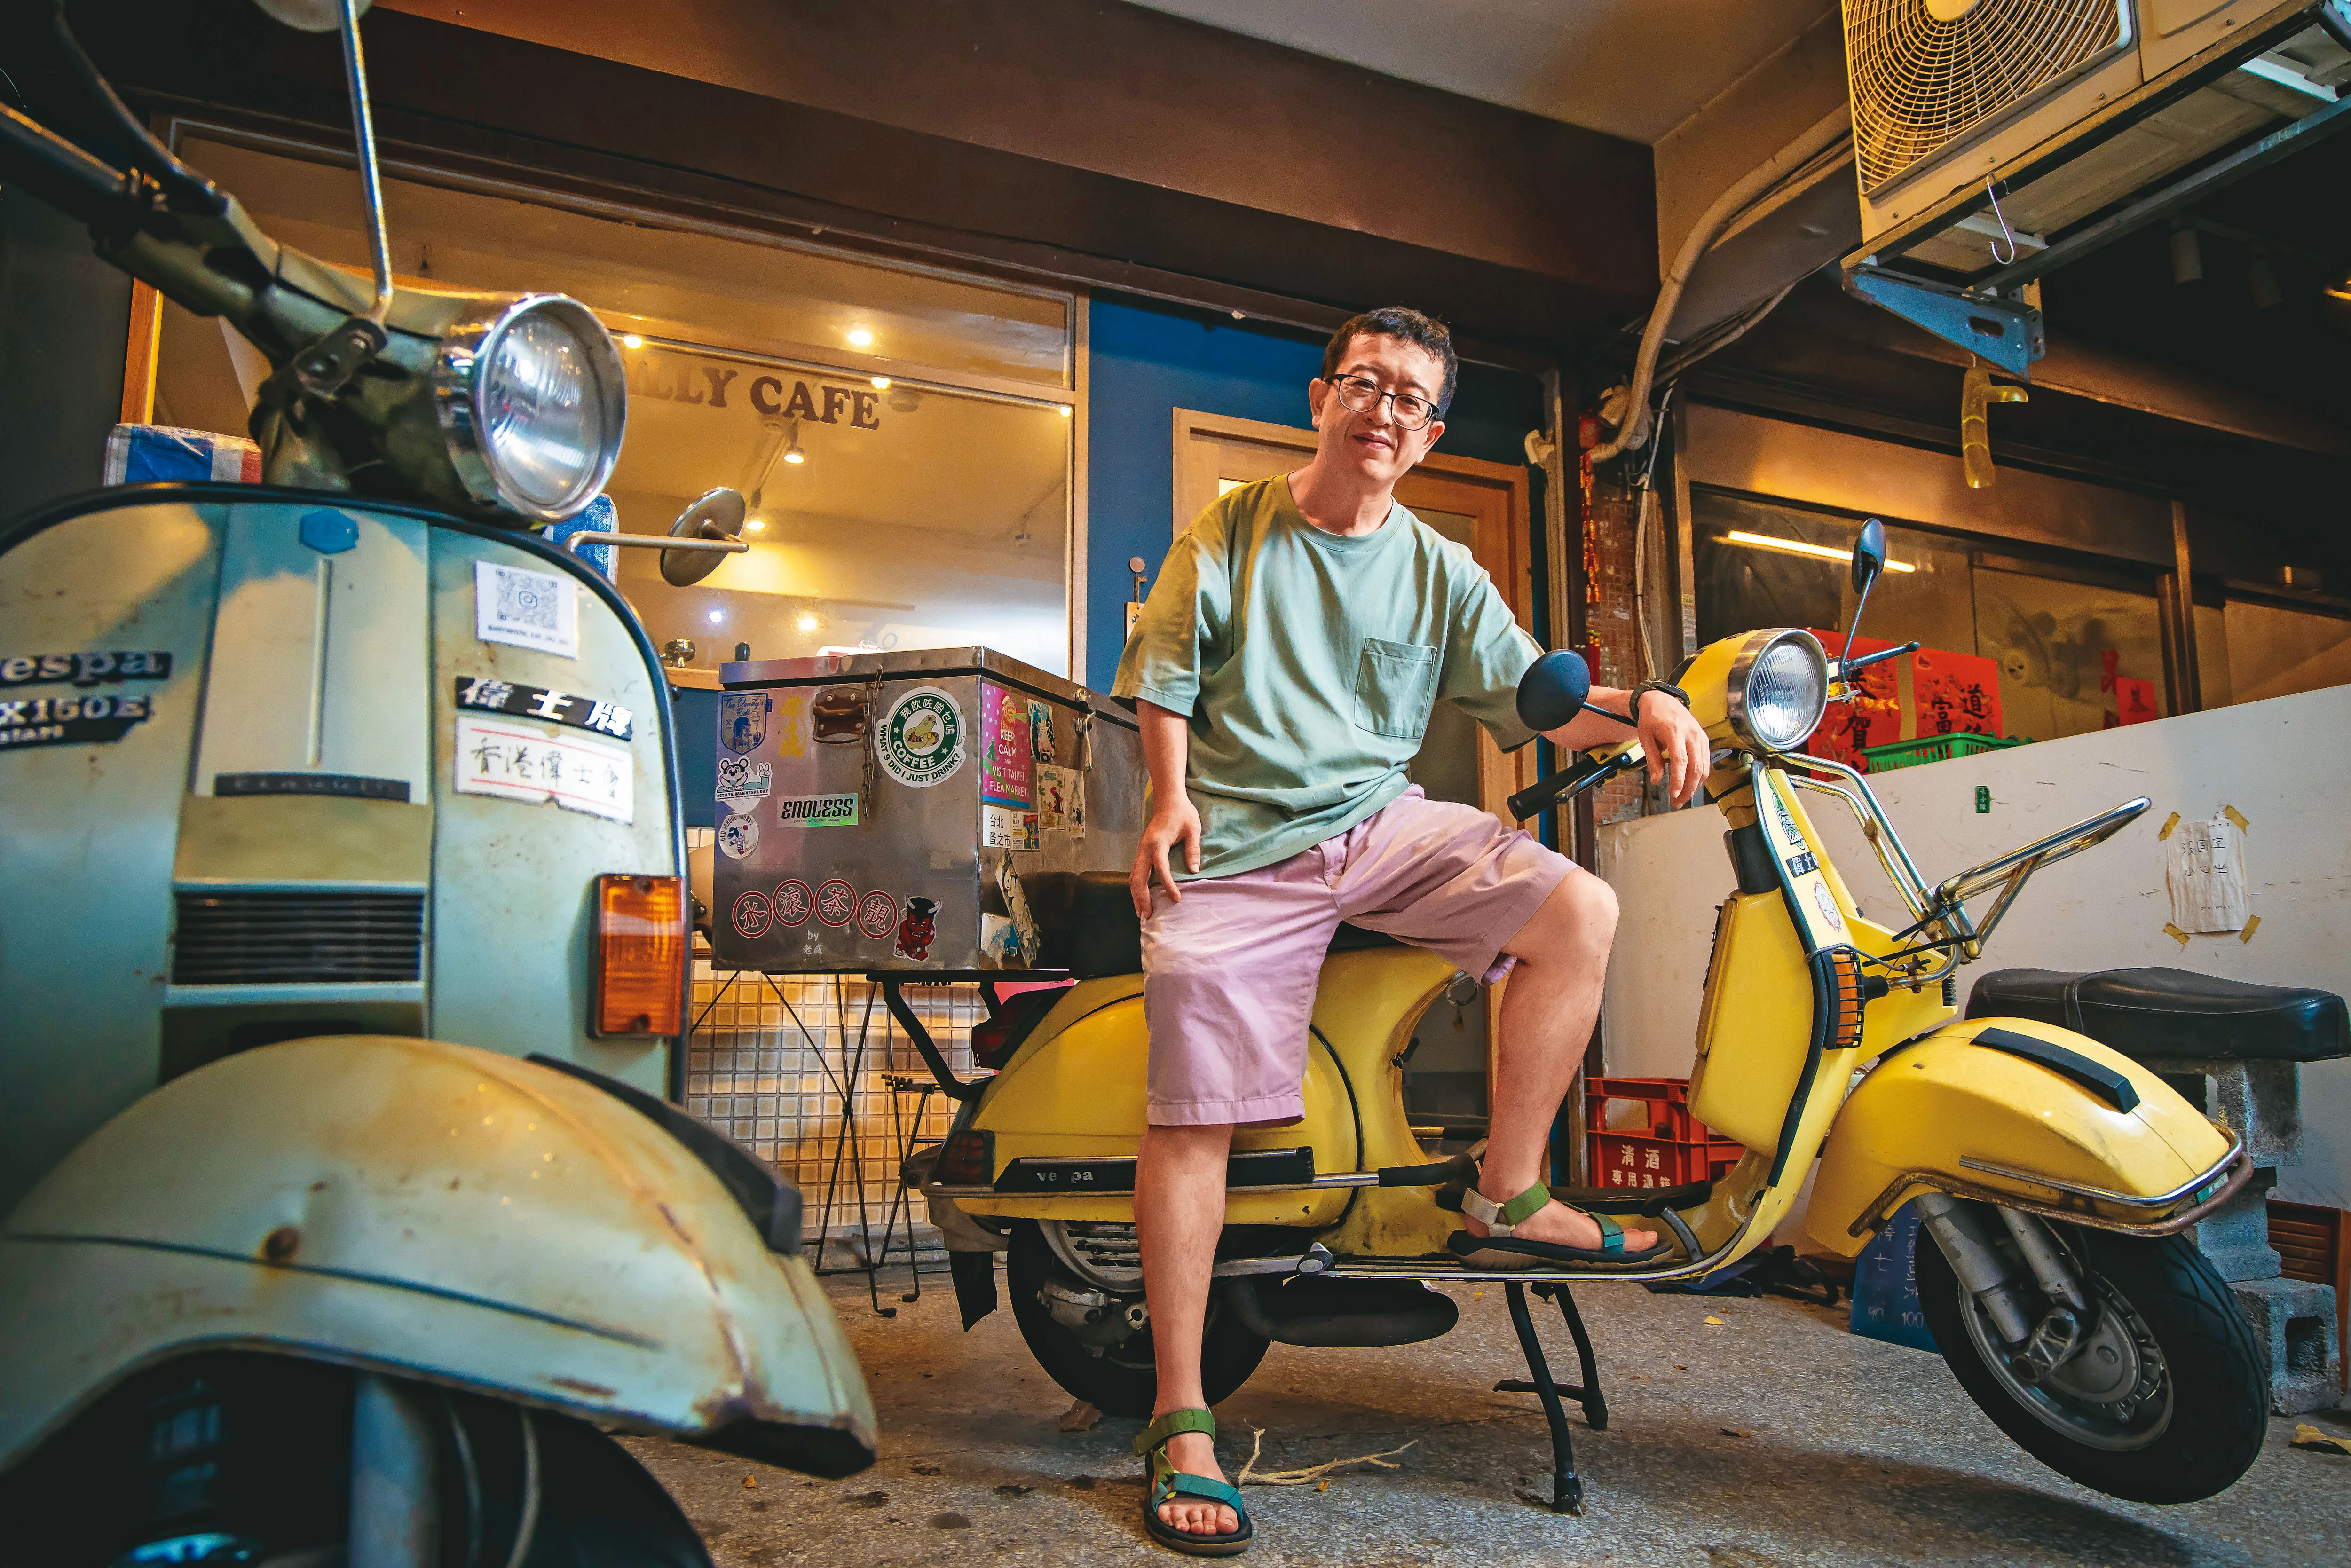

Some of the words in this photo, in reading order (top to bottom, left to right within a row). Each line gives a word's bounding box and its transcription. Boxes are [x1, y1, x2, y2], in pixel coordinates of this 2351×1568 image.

[750, 376, 880, 430] CAFE
[724, 698, 735, 709] The
[737, 697, 764, 710] Dandy's
[736, 707, 751, 716] Ride
[1000, 729, 1015, 741] KEEP
[879, 725, 888, 752] WHAT
[888, 760, 901, 774] DID
[931, 752, 960, 780] DRINK?
[893, 741, 936, 768] COFFEE
[999, 743, 1016, 756] CALM
[992, 765, 1006, 778] VISIT
[1008, 768, 1025, 782] TAIPEI
[990, 780, 1005, 793] FLEA
[1006, 783, 1027, 797] MARKET
[781, 798, 853, 819] ENDLESS
[723, 815, 737, 831] SCHOOL
[990, 814, 1003, 828] 台北
[989, 832, 1010, 848] 蚤之市
[807, 930, 819, 942] by
[1621, 1144, 1660, 1170] 清酒
[1901, 1311, 1925, 1328] 100
